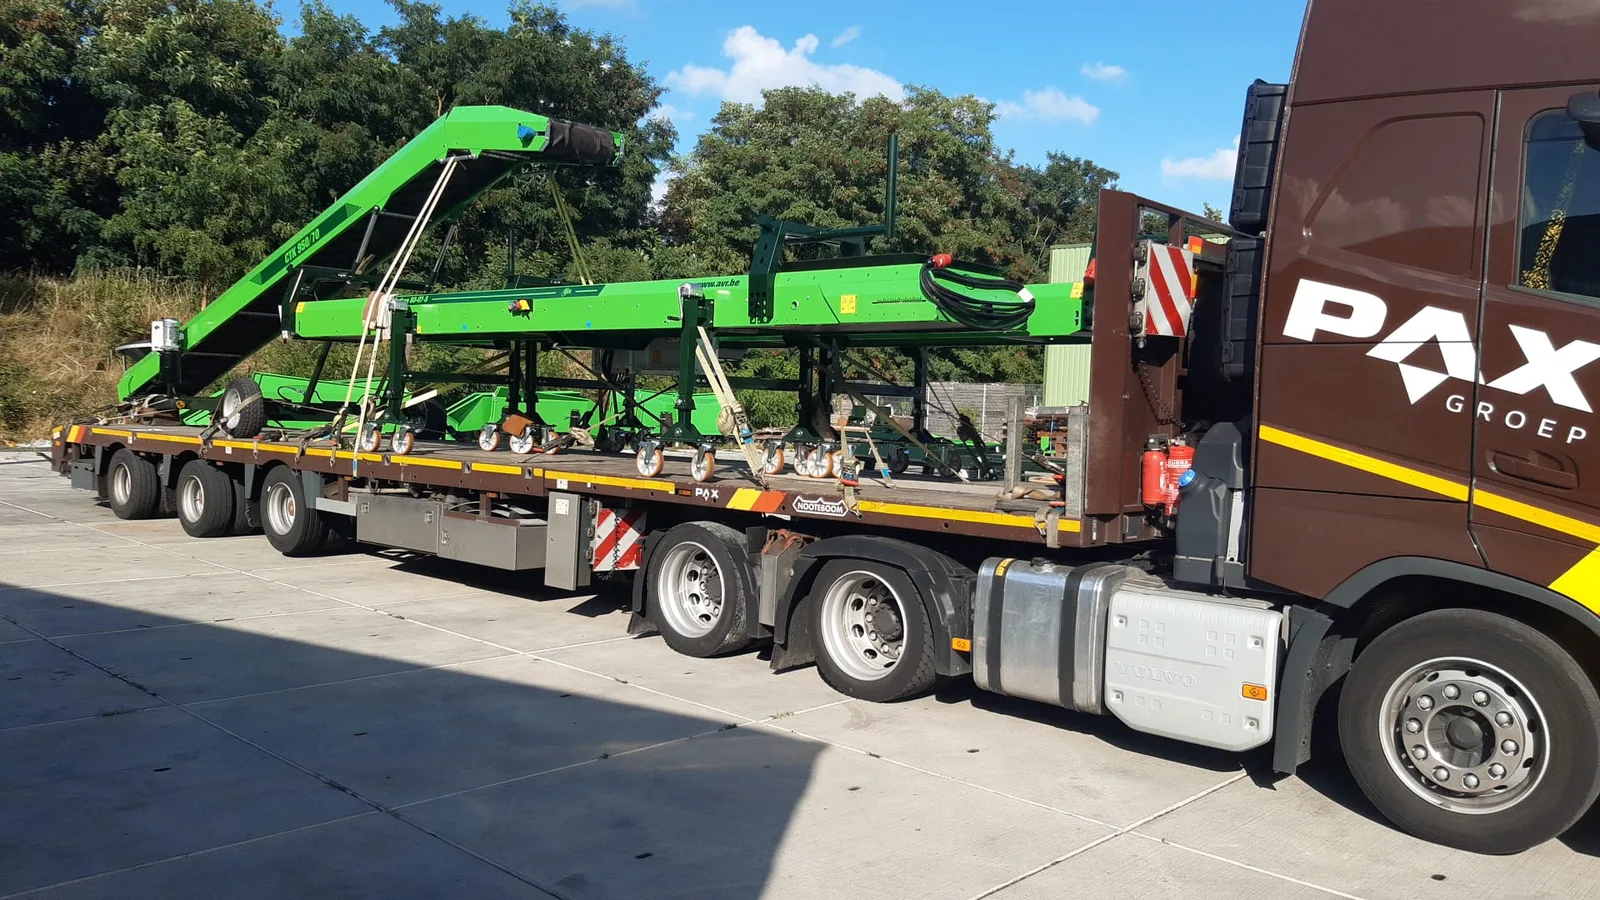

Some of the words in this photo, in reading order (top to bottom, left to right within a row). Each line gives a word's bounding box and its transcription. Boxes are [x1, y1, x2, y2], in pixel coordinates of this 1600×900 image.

[284, 246, 297, 263] CTK
[697, 278, 740, 288] ww.avr.be
[1282, 278, 1600, 413] PAX
[1446, 394, 1587, 444] GROEP
[695, 487, 719, 501] PAX
[797, 502, 844, 514] NOOTEBOOM
[1113, 660, 1197, 687] VOLVO
